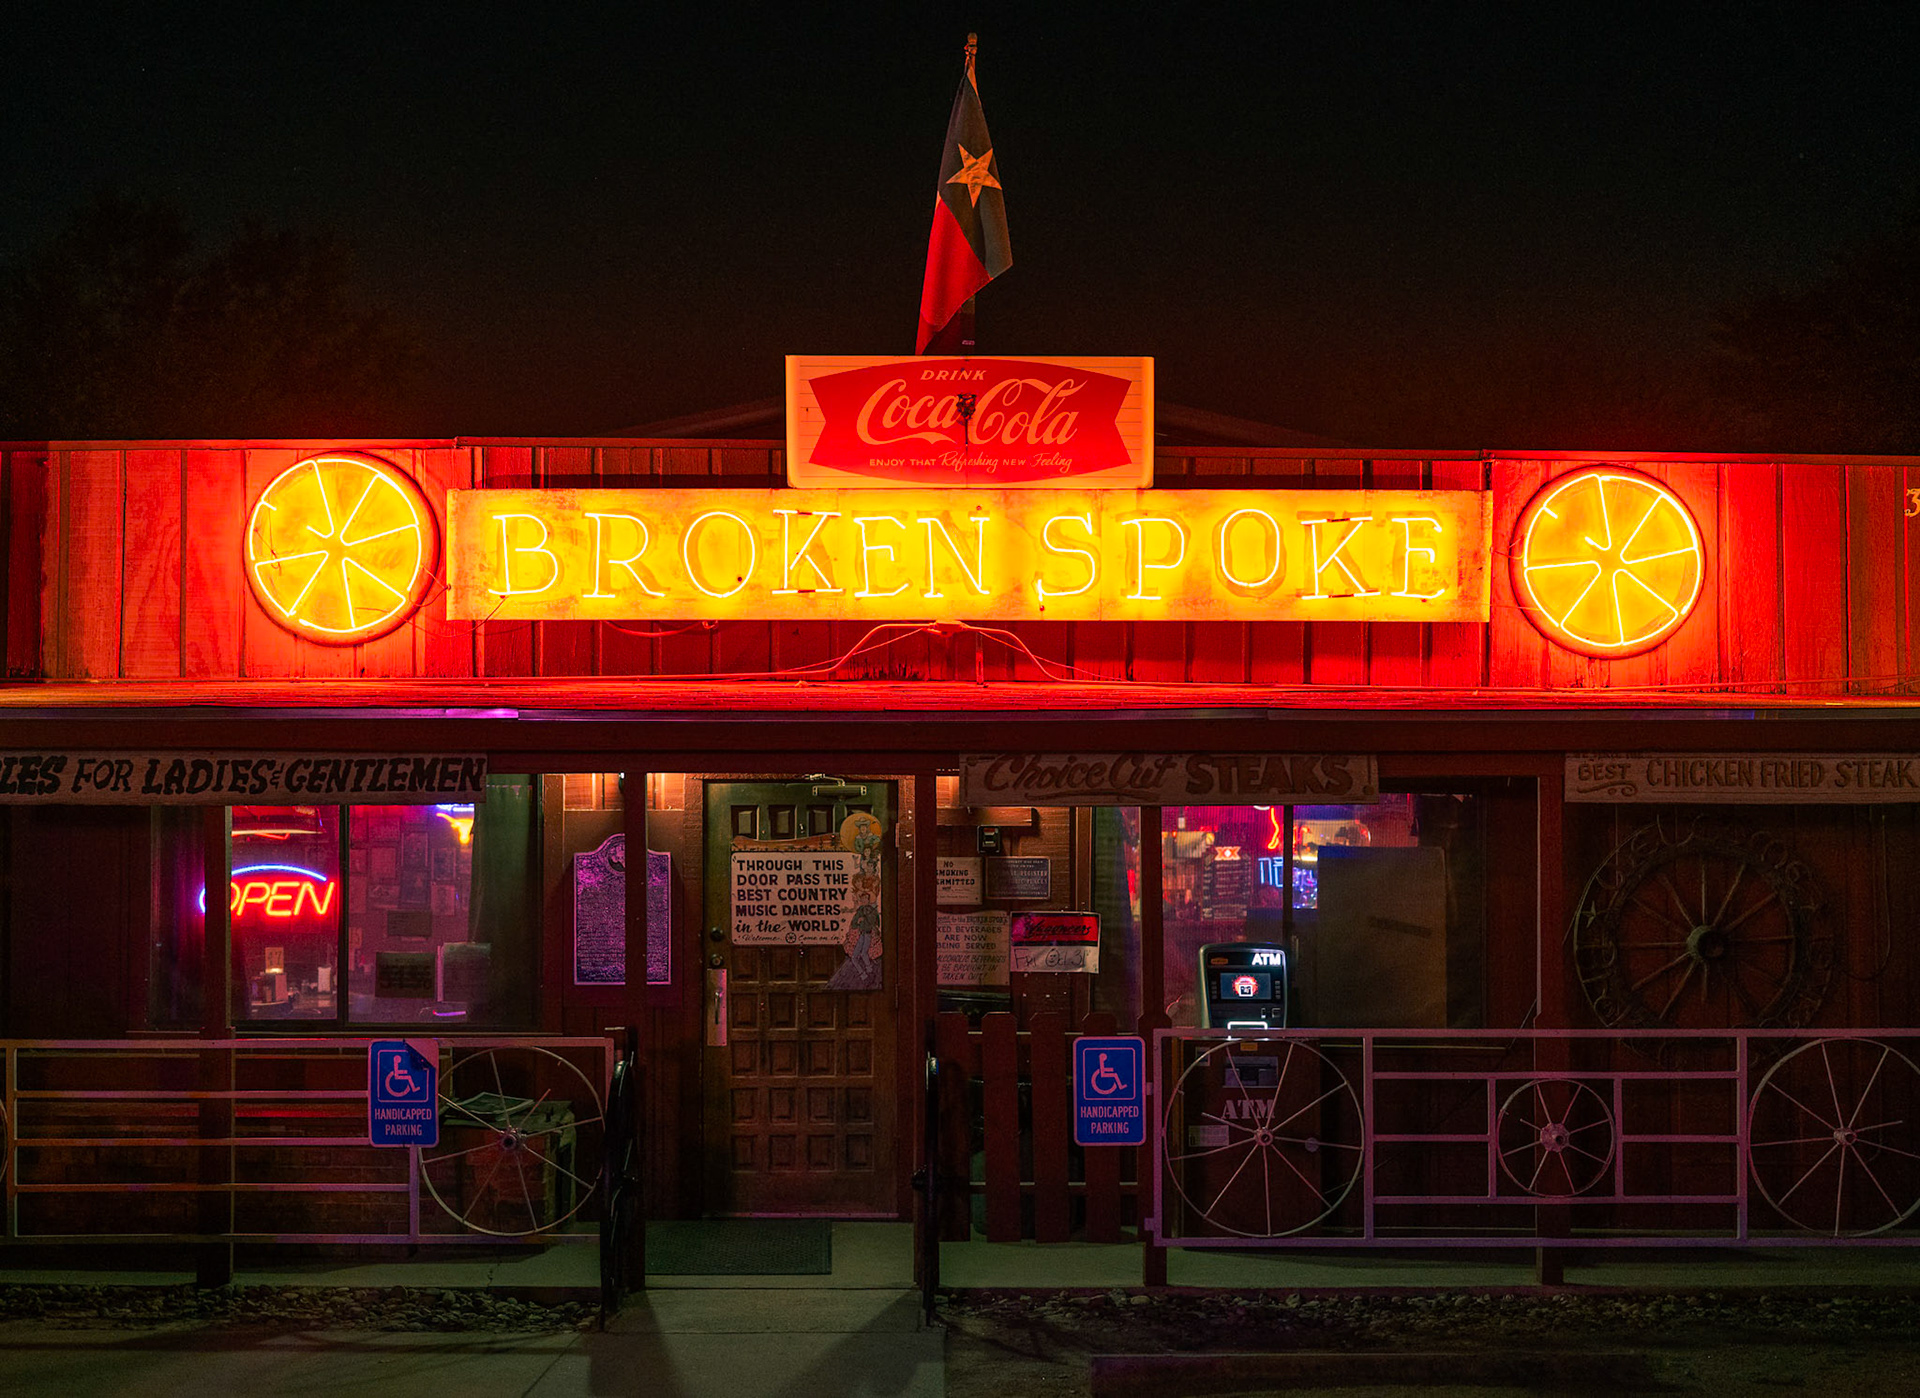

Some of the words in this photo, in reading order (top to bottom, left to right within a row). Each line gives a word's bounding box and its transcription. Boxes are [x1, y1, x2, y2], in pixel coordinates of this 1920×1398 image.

[920, 369, 987, 381] DRINK
[869, 458, 908, 467] ENJOY
[909, 458, 937, 466] THAT
[938, 450, 998, 473] Refreshing
[1002, 458, 1026, 466] NEW
[1030, 452, 1073, 473] Feeling
[486, 508, 990, 598] BROKEN
[1033, 508, 1450, 600] SPOKE
[0, 756, 67, 795] LES
[71, 758, 133, 793] FOR
[142, 758, 273, 794] LADIES
[284, 757, 485, 793] GENTLEMEN
[984, 753, 1106, 791] Choice
[1108, 753, 1180, 791] Cut
[1185, 754, 1354, 796] STEAKS
[1578, 763, 1631, 781] BEST
[1646, 758, 1754, 788] CHICKEN
[1760, 759, 1825, 788] FRIED
[1835, 759, 1919, 788] STEAK
[812, 859, 844, 871] THIS
[943, 860, 954, 868] NO
[737, 874, 778, 886] DOOR
[786, 874, 820, 885] PASS
[824, 874, 849, 885] THE
[936, 878, 975, 886] ERMITTED
[231, 882, 334, 916] PEN
[737, 889, 772, 901] BEST
[777, 888, 848, 901] COUNTRY
[736, 905, 778, 916] MUSIC
[782, 904, 841, 916] DANCERS
[735, 920, 752, 933] in
[755, 920, 786, 933] the
[1251, 953, 1281, 966] ATM
[375, 1108, 432, 1120] HANDICAPPED
[1080, 1106, 1139, 1118] HANDICAPPED
[1221, 1099, 1276, 1120] ATM
[385, 1124, 423, 1136] PARKING
[1091, 1122, 1130, 1134] PARKING
